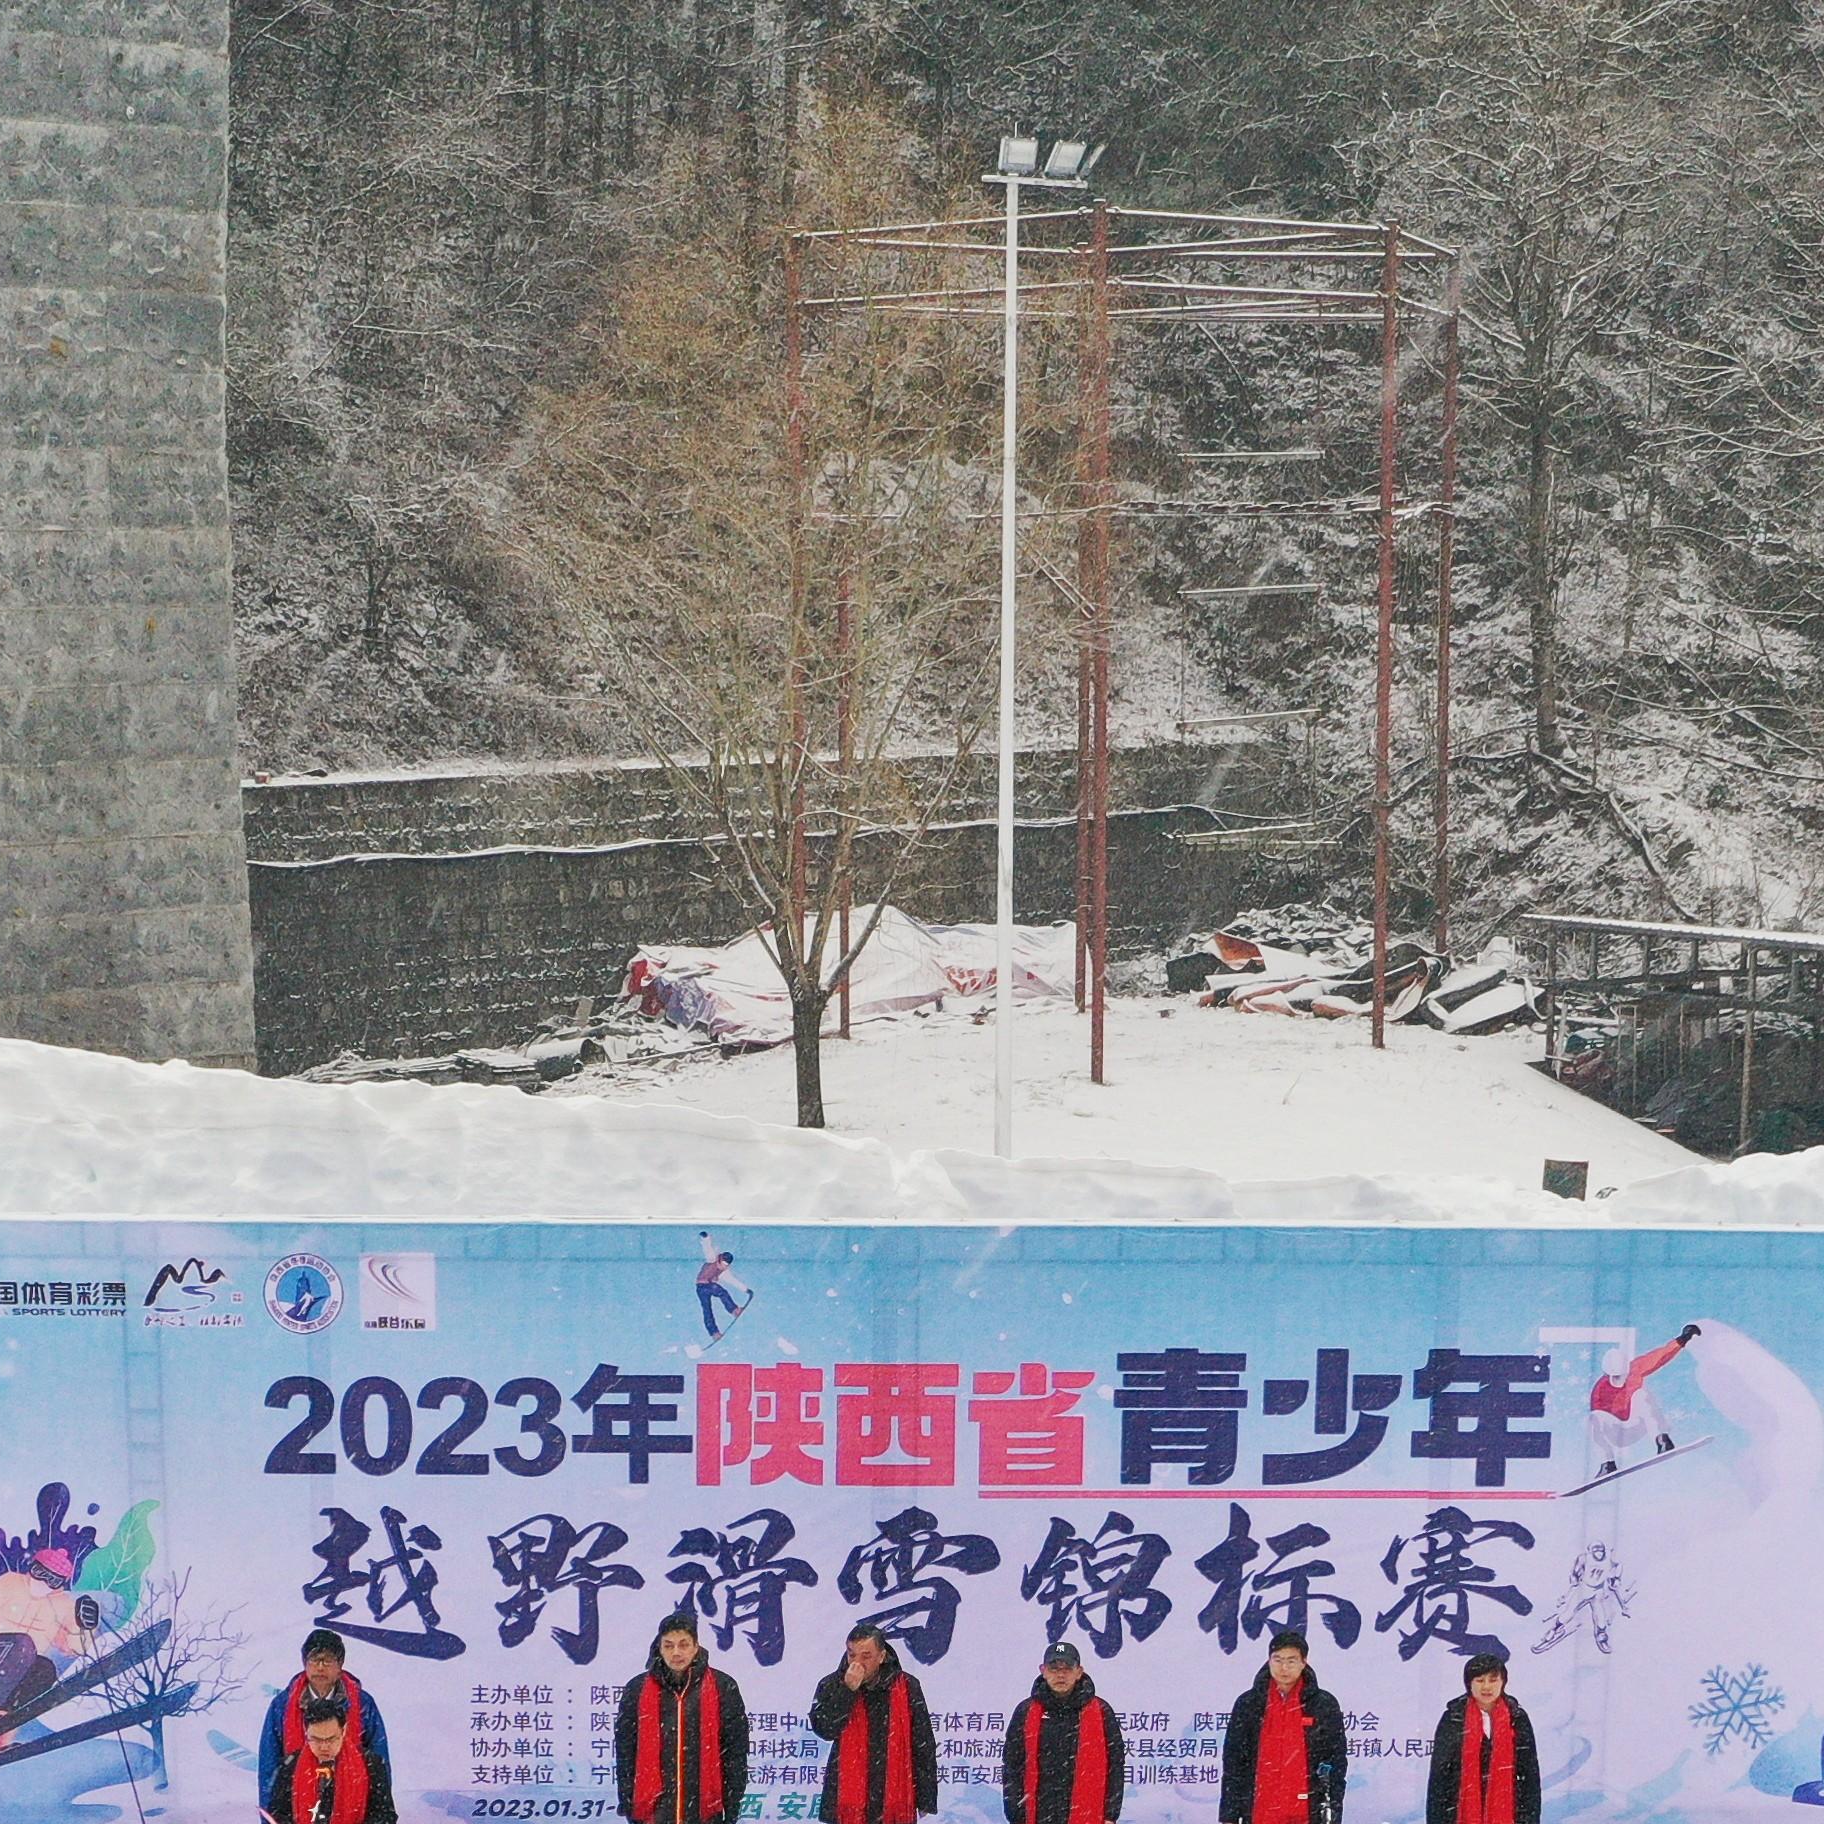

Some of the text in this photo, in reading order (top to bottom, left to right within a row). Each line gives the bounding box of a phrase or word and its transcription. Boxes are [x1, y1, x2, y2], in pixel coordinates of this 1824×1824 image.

[12, 1308, 66, 1316] SPORTS
[71, 1309, 127, 1317] LOTTERY
[263, 1348, 1552, 1486] 2023年陕西省青少年
[302, 1503, 1536, 1666] 越野滑雪锦标赛
[591, 1738, 617, 1758] 宁
[591, 1765, 617, 1785] 宁
